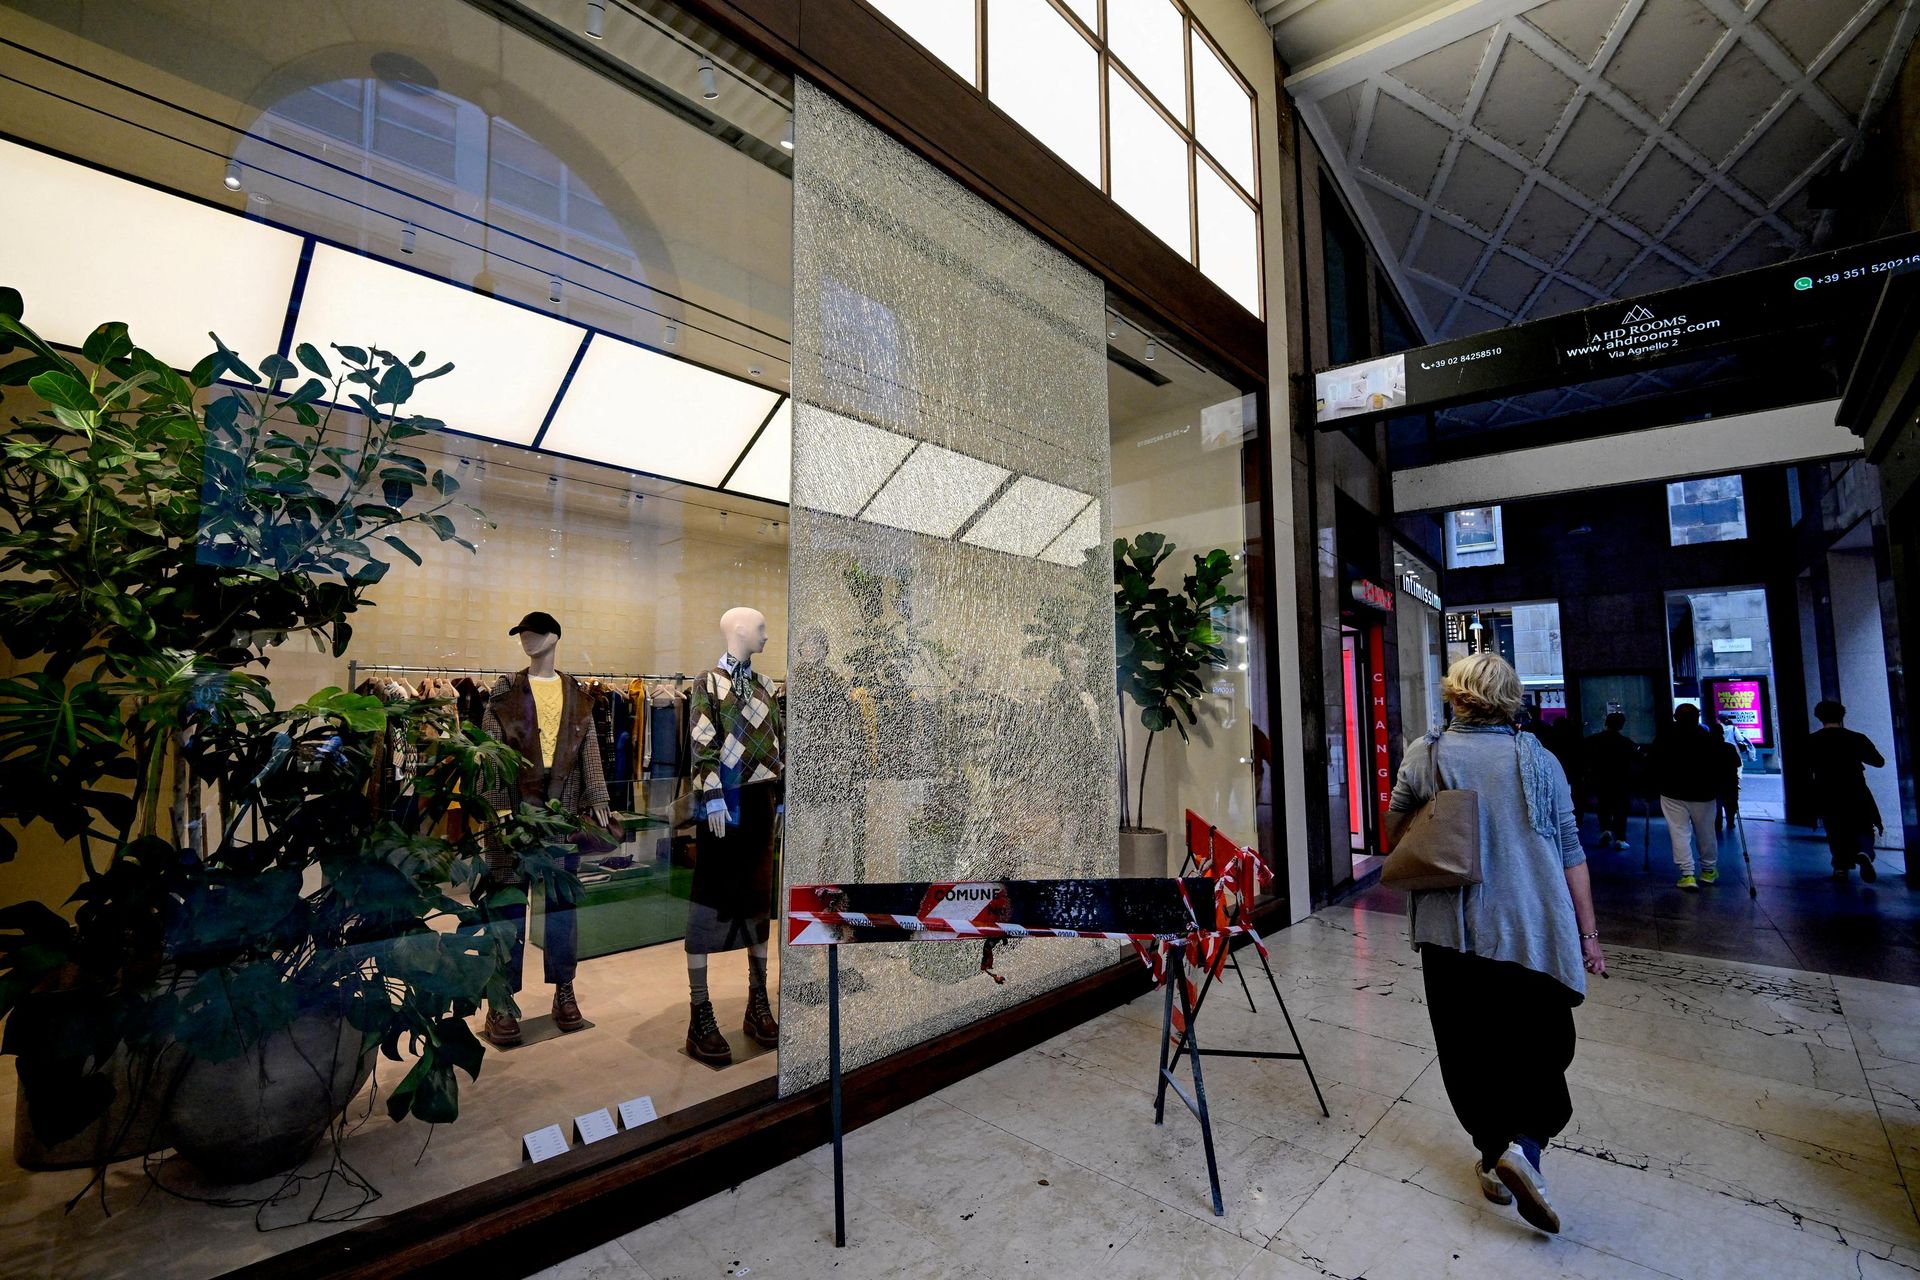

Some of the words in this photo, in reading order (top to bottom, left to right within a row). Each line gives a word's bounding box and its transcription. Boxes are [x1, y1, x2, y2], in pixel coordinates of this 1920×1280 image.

[1817, 274, 1839, 284] +39
[1843, 267, 1866, 280] 351
[1630, 315, 1687, 335] ROOMS
[1566, 319, 1721, 357] www.ahdrooms.com
[1431, 360, 1446, 368] +39
[1447, 357, 1458, 365] 02
[1460, 347, 1502, 363] 84258510
[1608, 351, 1625, 359] Via
[1627, 341, 1669, 356] Agnello
[1671, 339, 1679, 347] 2
[1373, 673, 1388, 802] CHANGE
[934, 888, 1001, 902] COMUNE
